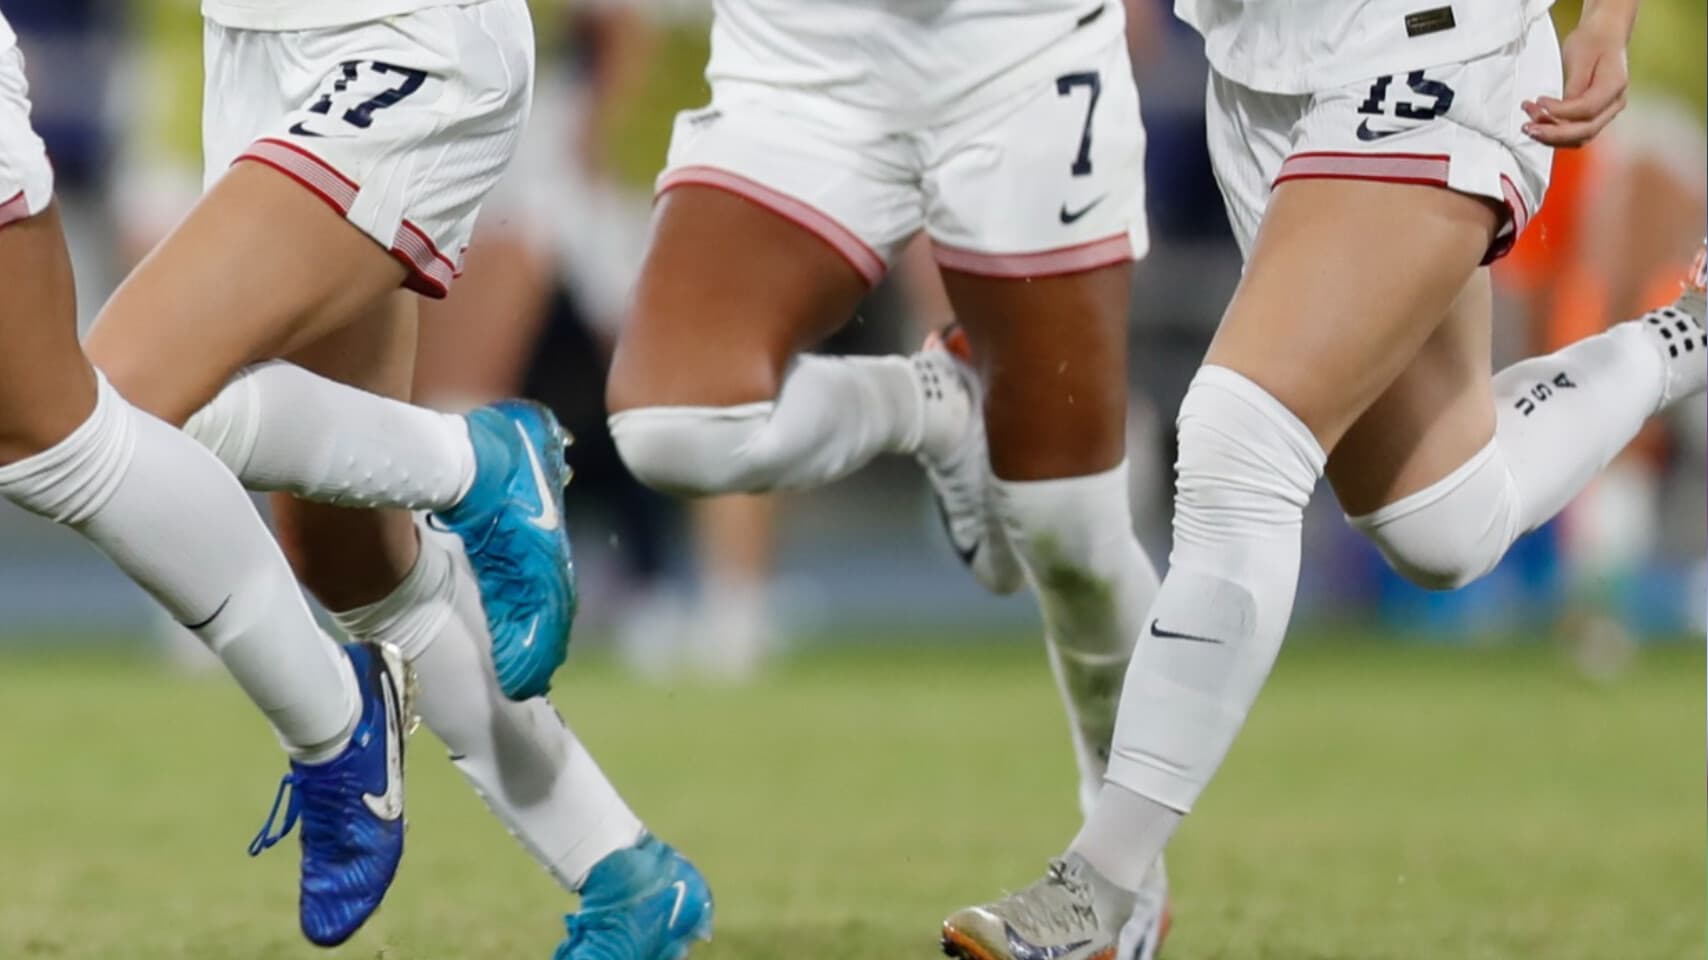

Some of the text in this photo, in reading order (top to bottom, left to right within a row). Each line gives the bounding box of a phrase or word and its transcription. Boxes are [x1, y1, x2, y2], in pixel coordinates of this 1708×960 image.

[308, 59, 428, 129] 17
[1055, 71, 1101, 176] 7
[1357, 69, 1455, 120] 15
[1514, 371, 1577, 416] USA
